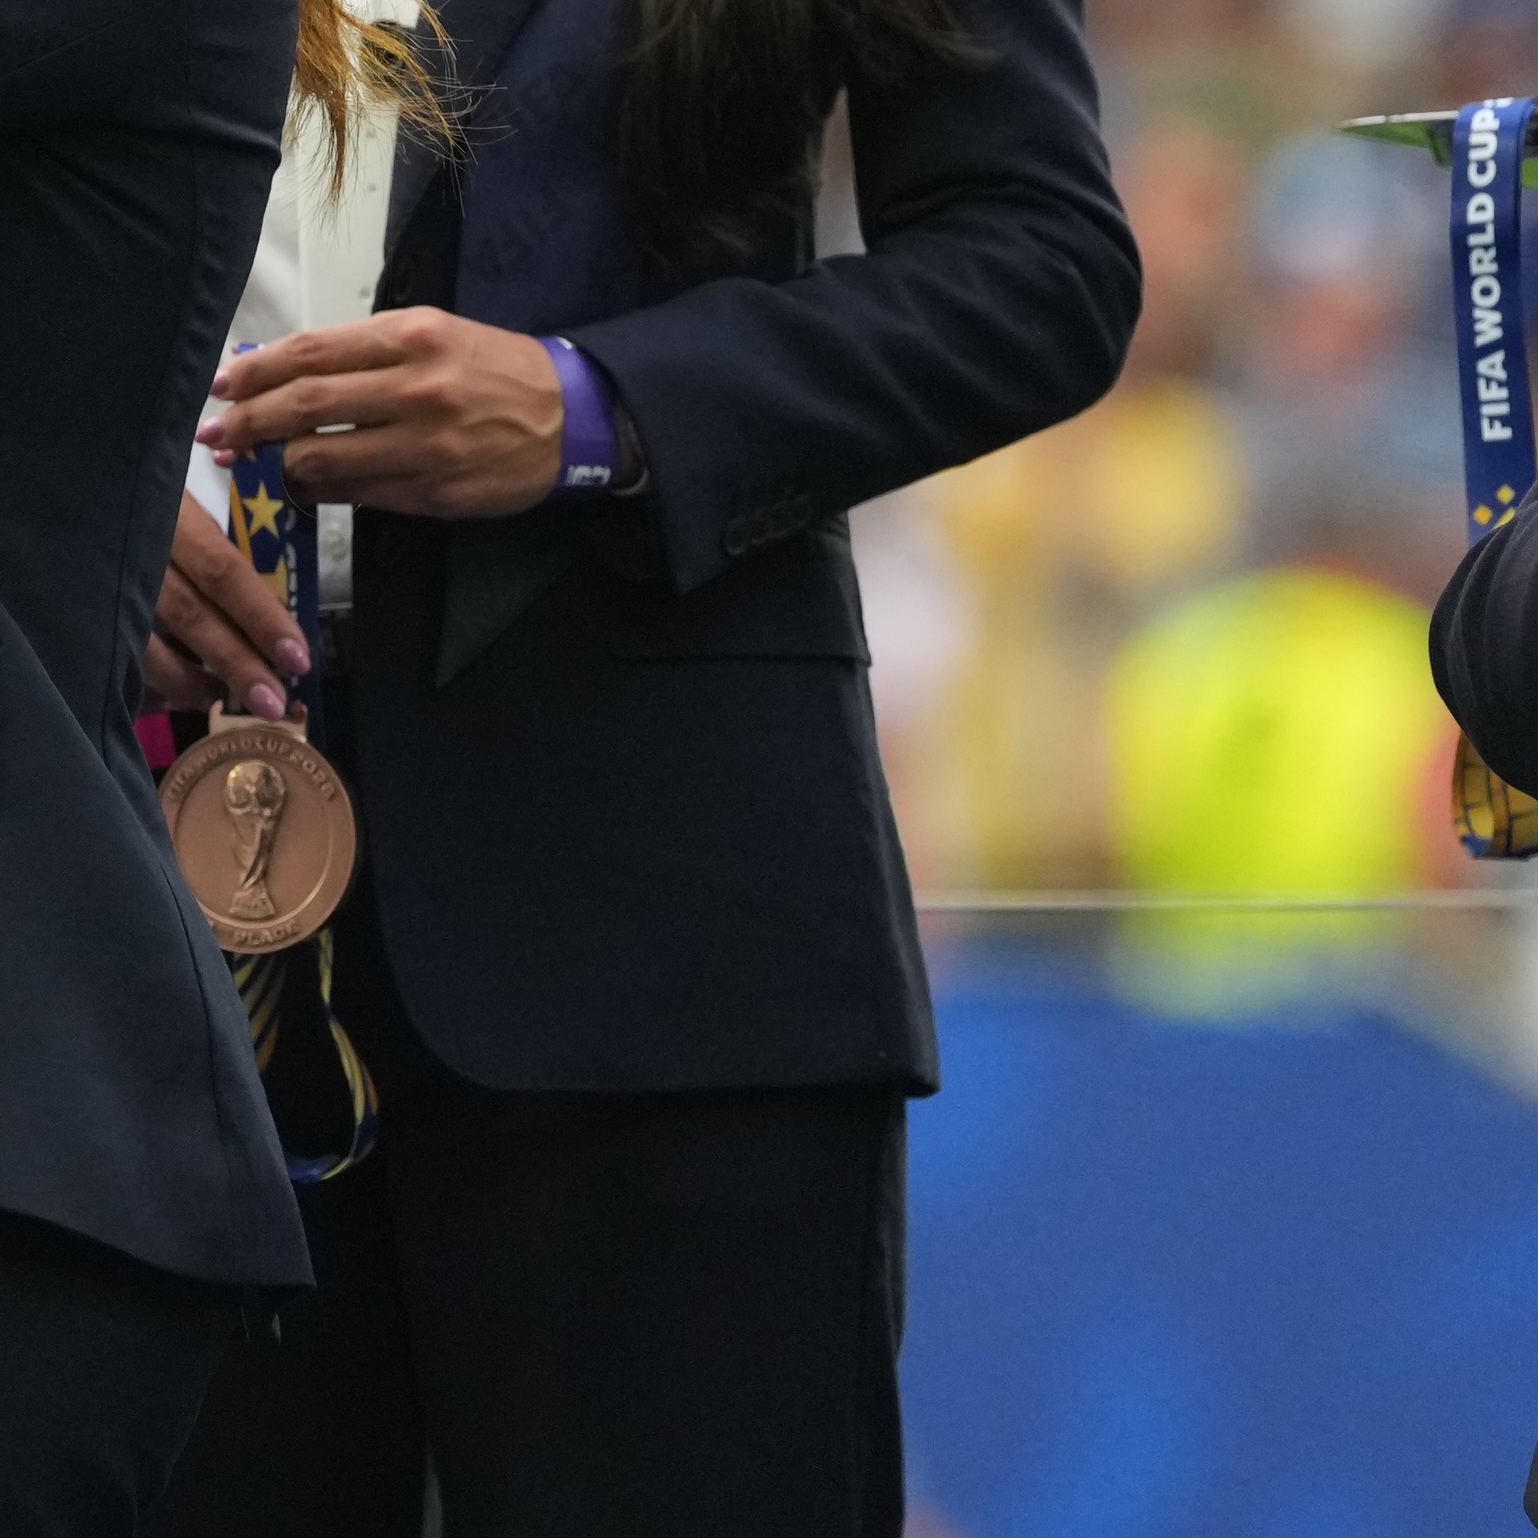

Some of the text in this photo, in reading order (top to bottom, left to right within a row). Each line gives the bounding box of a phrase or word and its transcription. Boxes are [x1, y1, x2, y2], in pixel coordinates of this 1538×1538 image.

[1467, 108, 1500, 189] CUP
[1466, 192, 1504, 347] WORLD
[1476, 349, 1513, 443] FIFA
